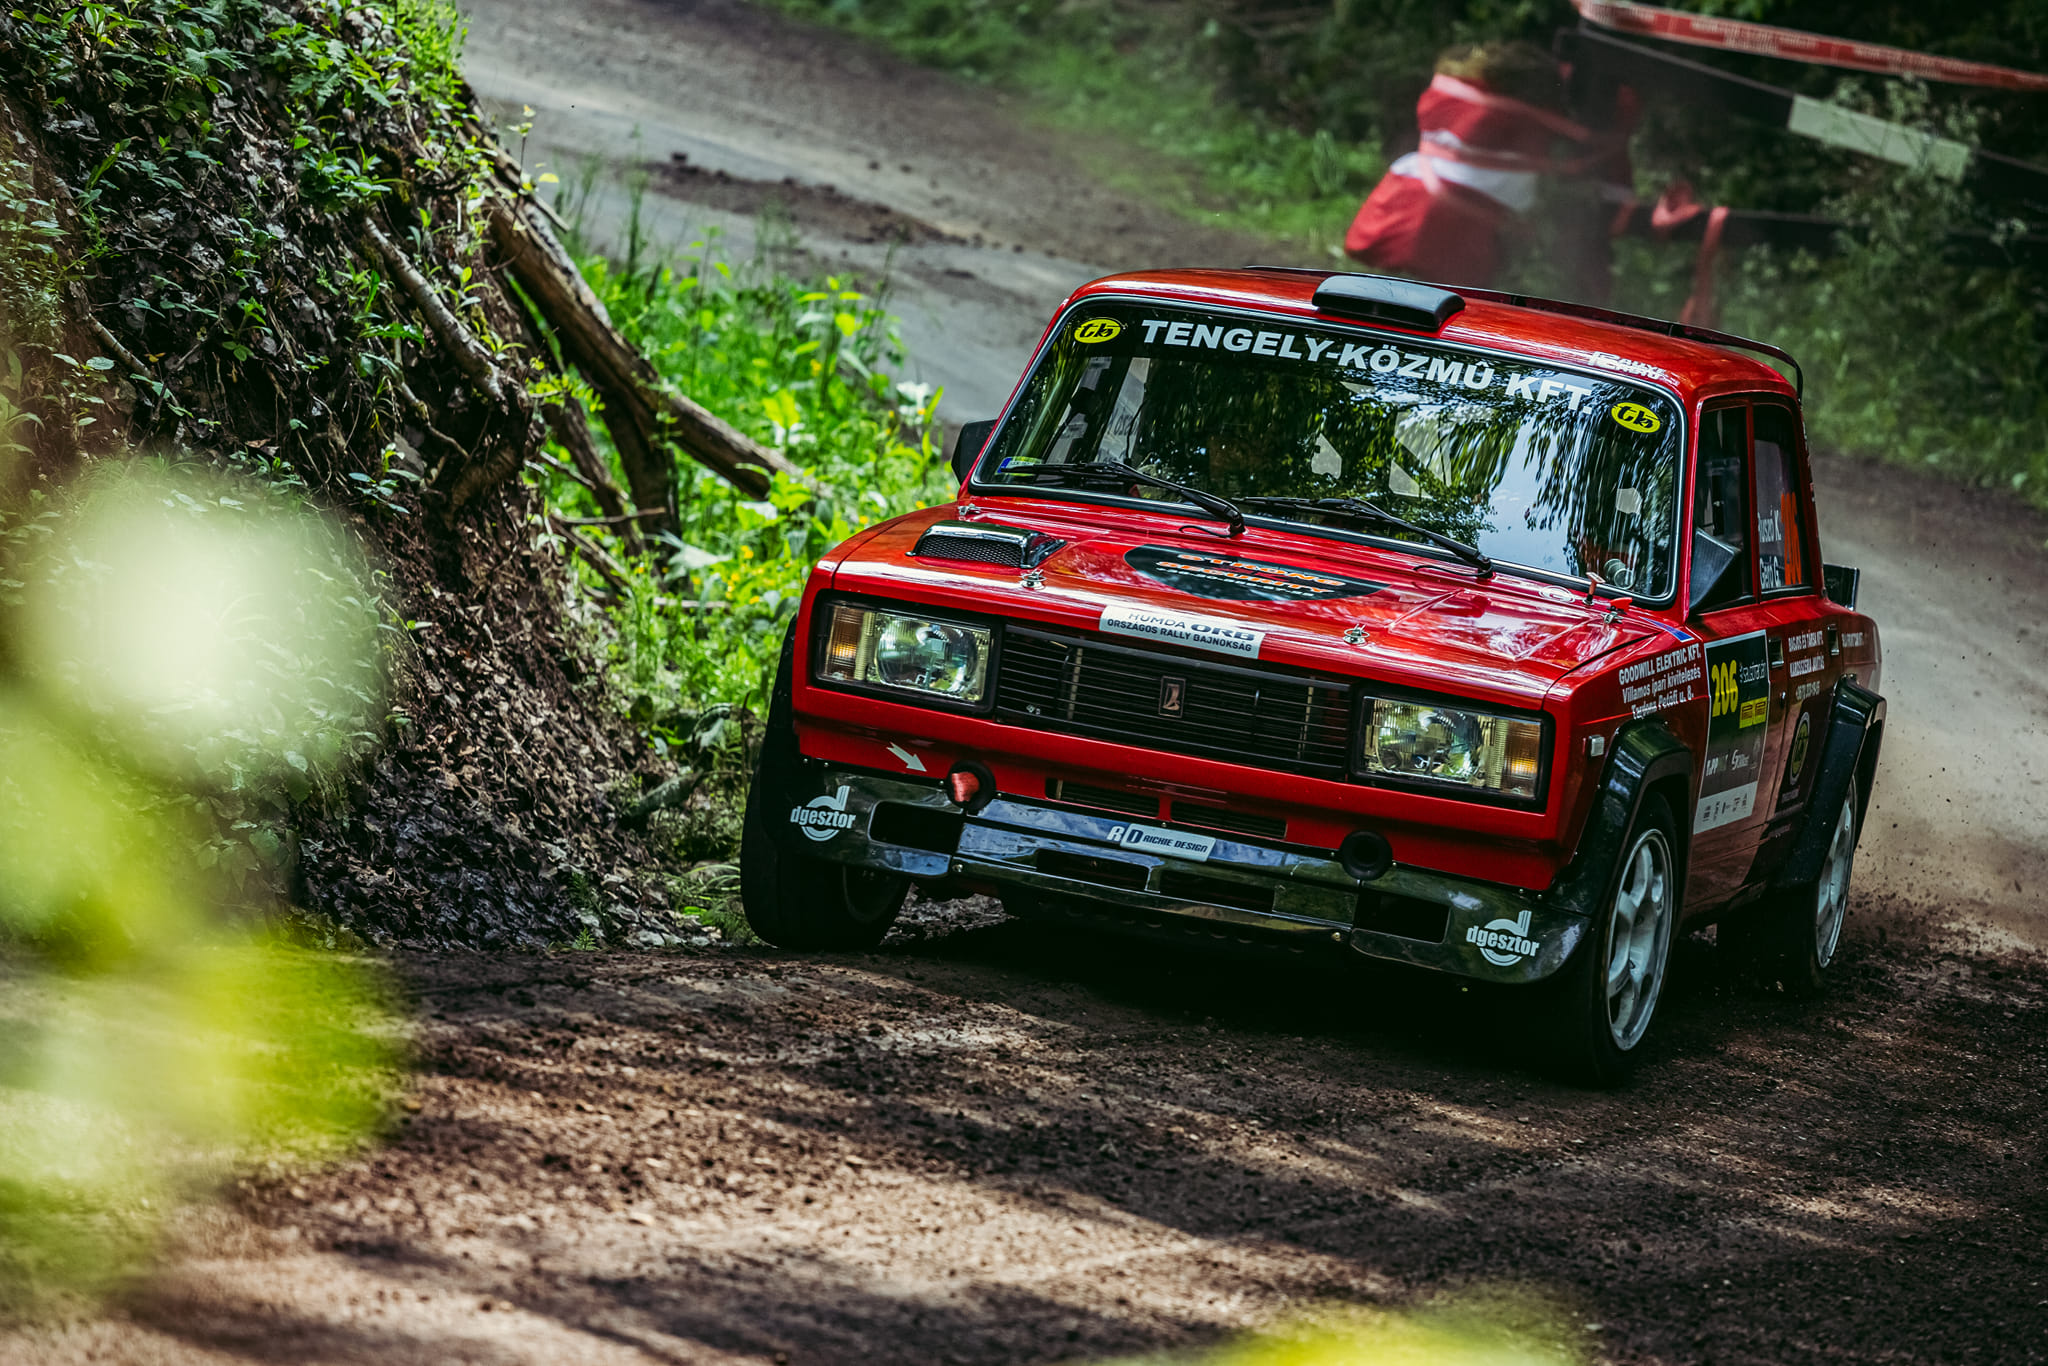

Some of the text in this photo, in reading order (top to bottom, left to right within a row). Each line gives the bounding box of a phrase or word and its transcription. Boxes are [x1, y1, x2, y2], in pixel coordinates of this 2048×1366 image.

[1505, 372, 1593, 415] KFT.
[1155, 561, 1335, 593] SECURITY
[1177, 553, 1347, 587] STRONG
[1107, 617, 1253, 652] ORSZÁGOS RALLY BAJNOKSÁG
[1128, 612, 1255, 642] HUMDA ORB
[1618, 659, 1656, 685] GOODWILL
[1656, 647, 1687, 673] ELEKTRIC
[1622, 683, 1651, 704] Villamos
[1667, 663, 1701, 689] kivitelezés
[1711, 659, 1739, 718] 206
[790, 805, 856, 829] dgesztor
[1142, 835, 1173, 847] RICHIE
[1174, 839, 1209, 853] DESIGN
[1466, 925, 1540, 957] dgesztor
